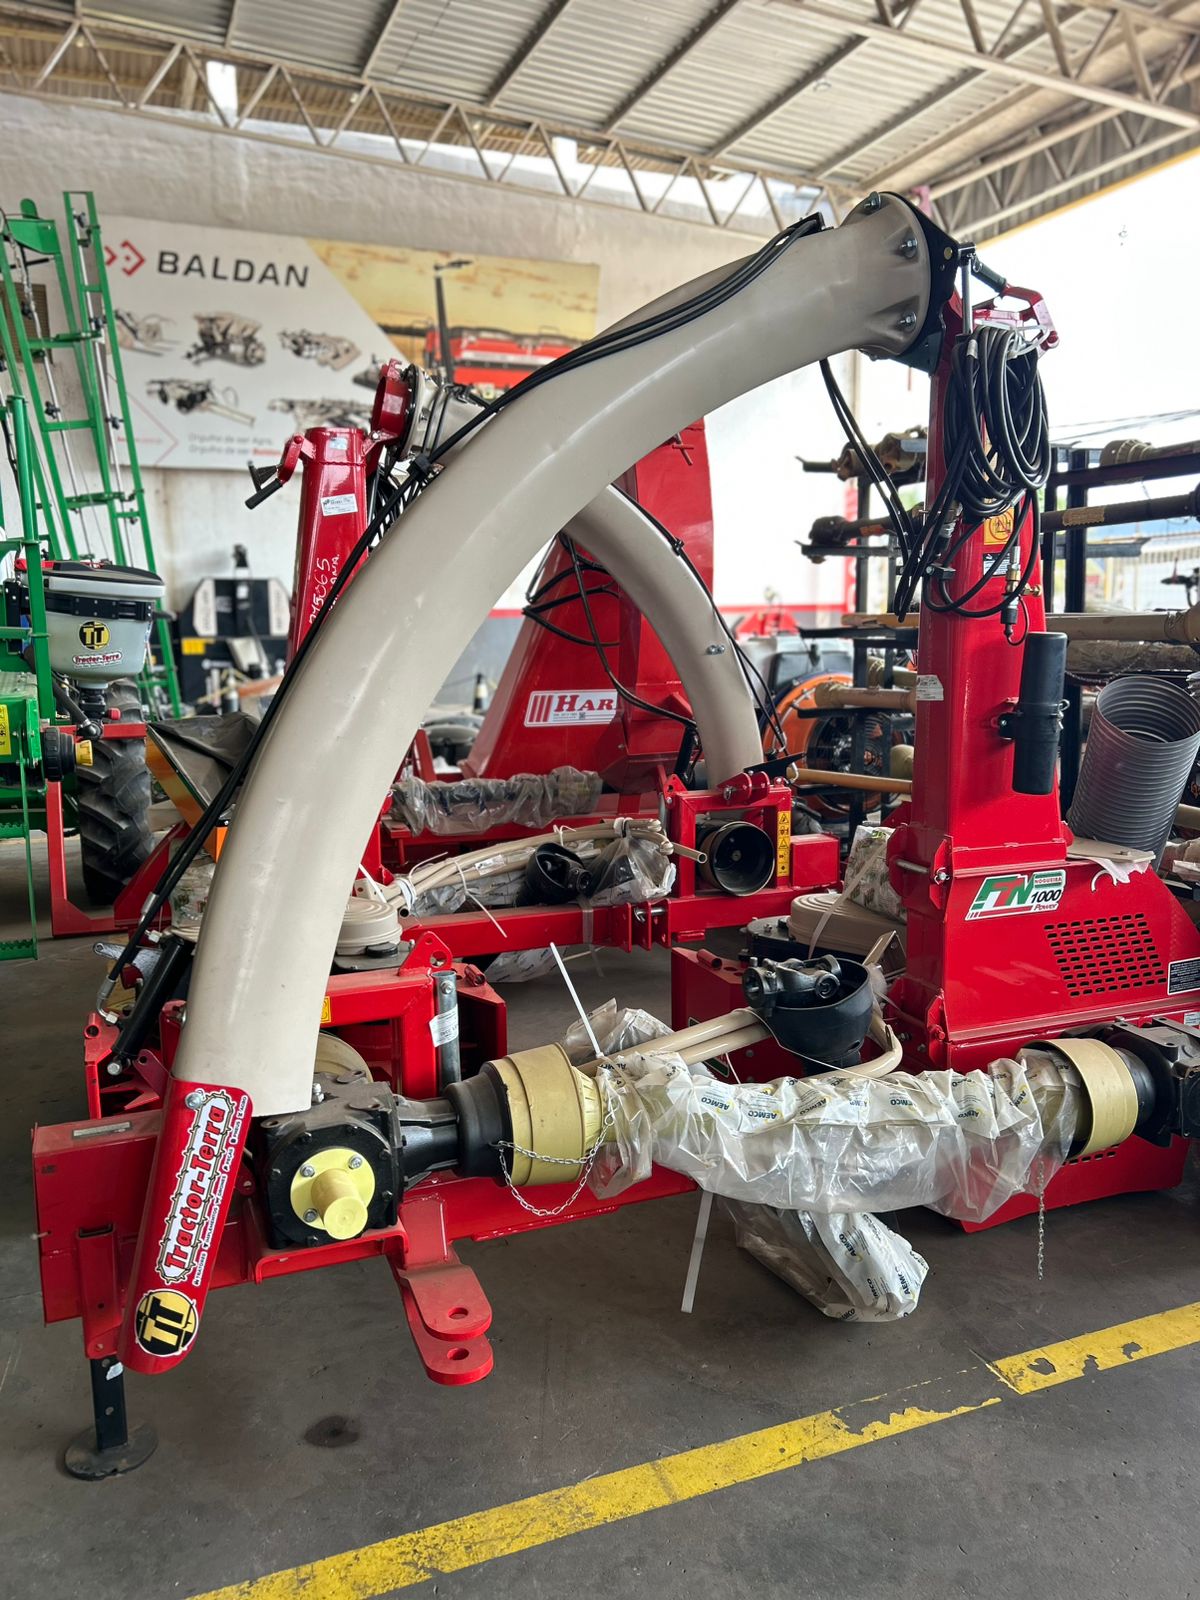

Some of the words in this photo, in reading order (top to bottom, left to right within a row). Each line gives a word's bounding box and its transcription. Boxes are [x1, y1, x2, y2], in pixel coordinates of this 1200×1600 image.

[157, 251, 309, 288] BALDAN
[1031, 889, 1062, 904] 1000
[1034, 903, 1057, 911] Power
[701, 1097, 730, 1111] AEMCO
[800, 1098, 827, 1115] AEMCO
[748, 1110, 777, 1120] AEMCO
[164, 1105, 226, 1270] Tractor-Terra
[839, 1233, 857, 1257] AEMCO
[143, 1295, 185, 1347] TT
